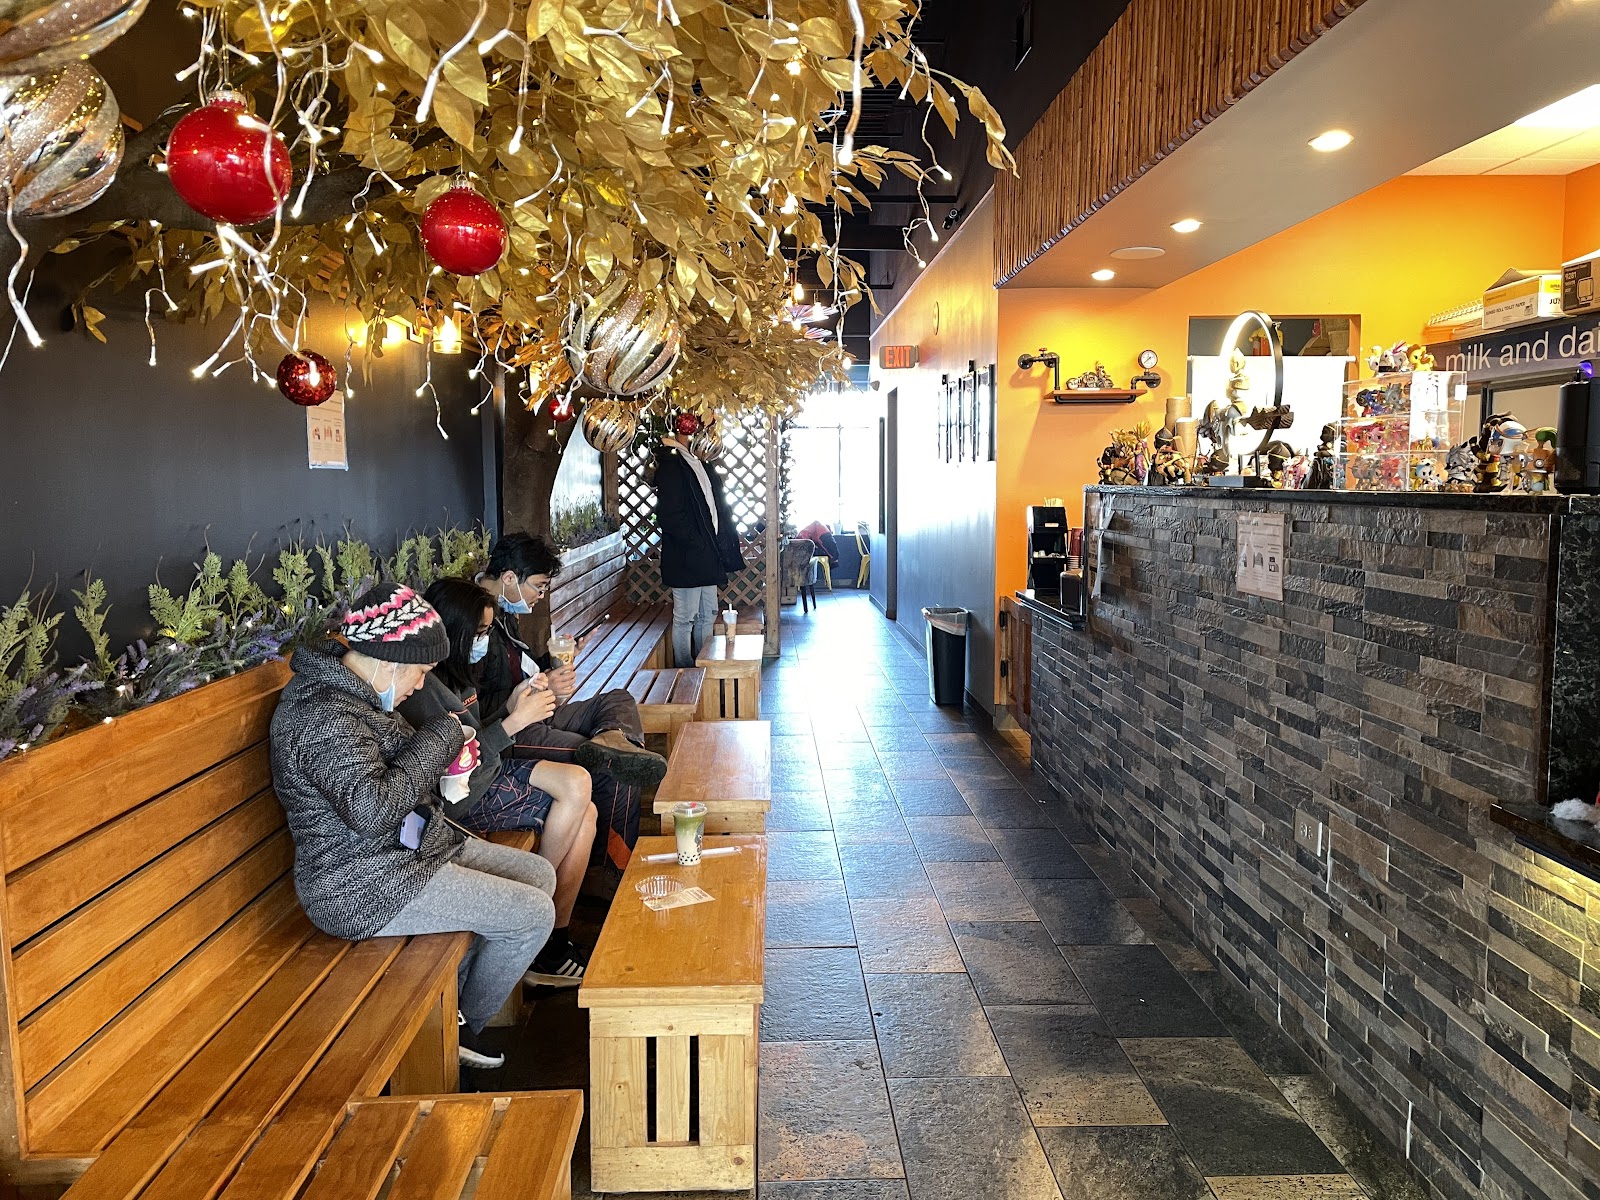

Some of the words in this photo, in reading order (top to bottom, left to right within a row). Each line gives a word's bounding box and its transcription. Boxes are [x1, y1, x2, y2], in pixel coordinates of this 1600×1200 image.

[885, 346, 912, 368] EXIT
[1446, 342, 1492, 371] milk
[1500, 331, 1549, 367] and
